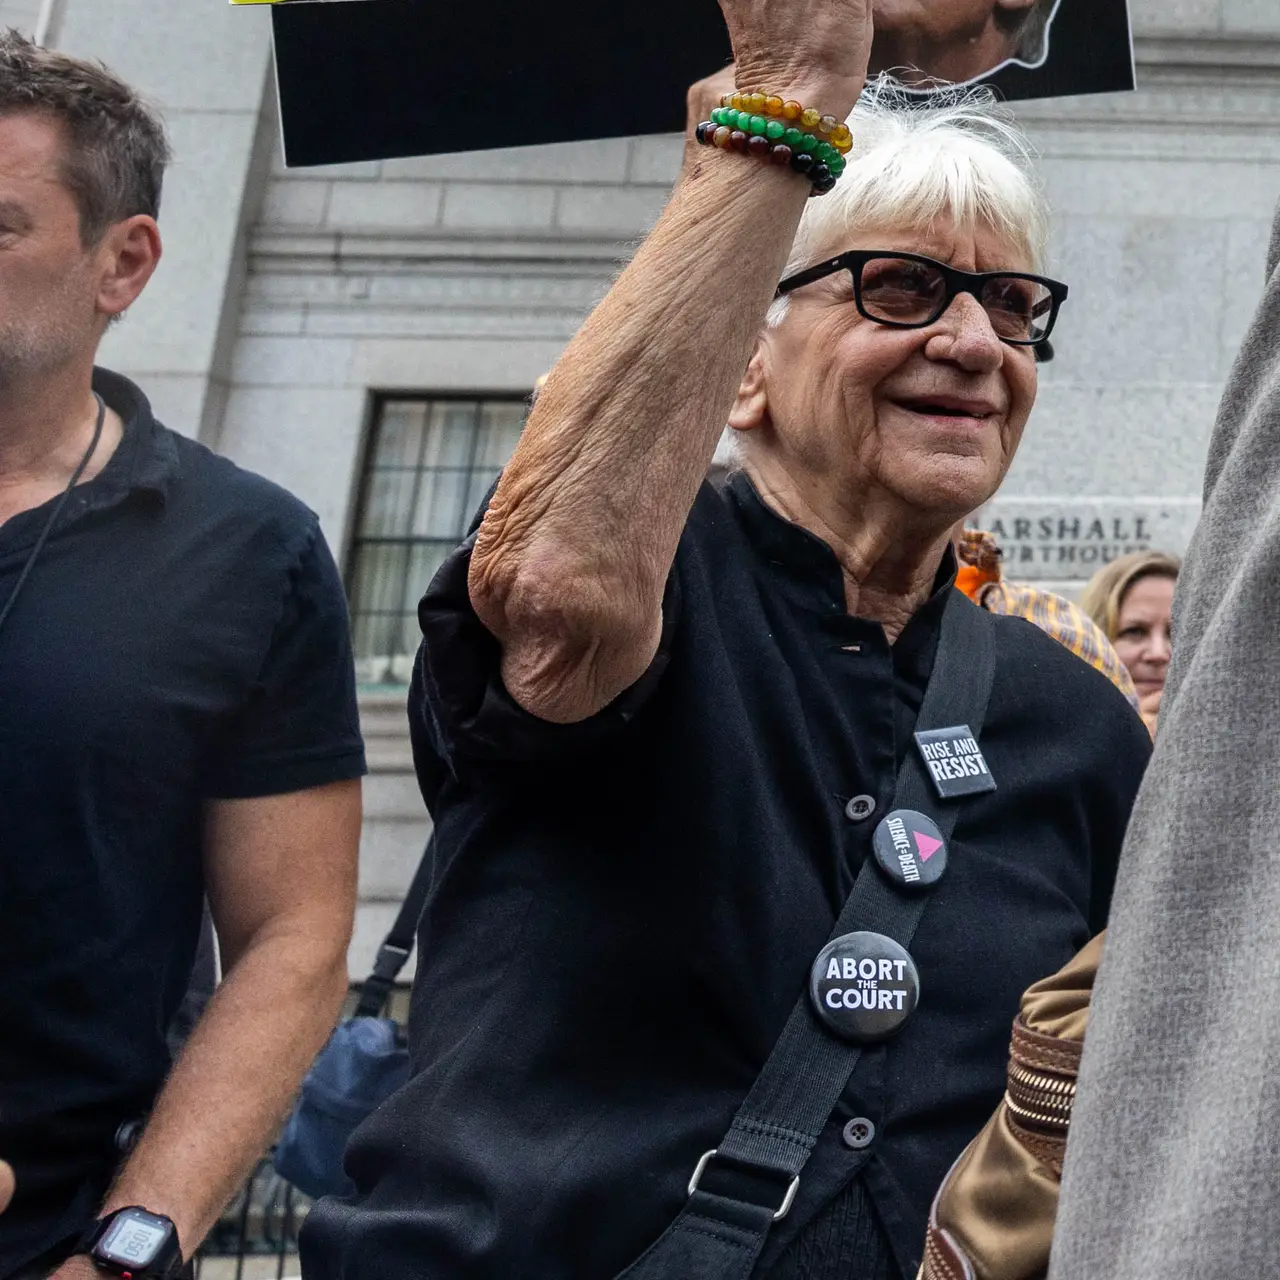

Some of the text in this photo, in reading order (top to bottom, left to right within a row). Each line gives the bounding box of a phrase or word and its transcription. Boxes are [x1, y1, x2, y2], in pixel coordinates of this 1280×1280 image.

[921, 738, 979, 761] RISE AND
[928, 753, 988, 781] RESIST
[826, 957, 907, 981] ABORT
[857, 979, 878, 989] THE
[826, 988, 907, 1010] COURT
